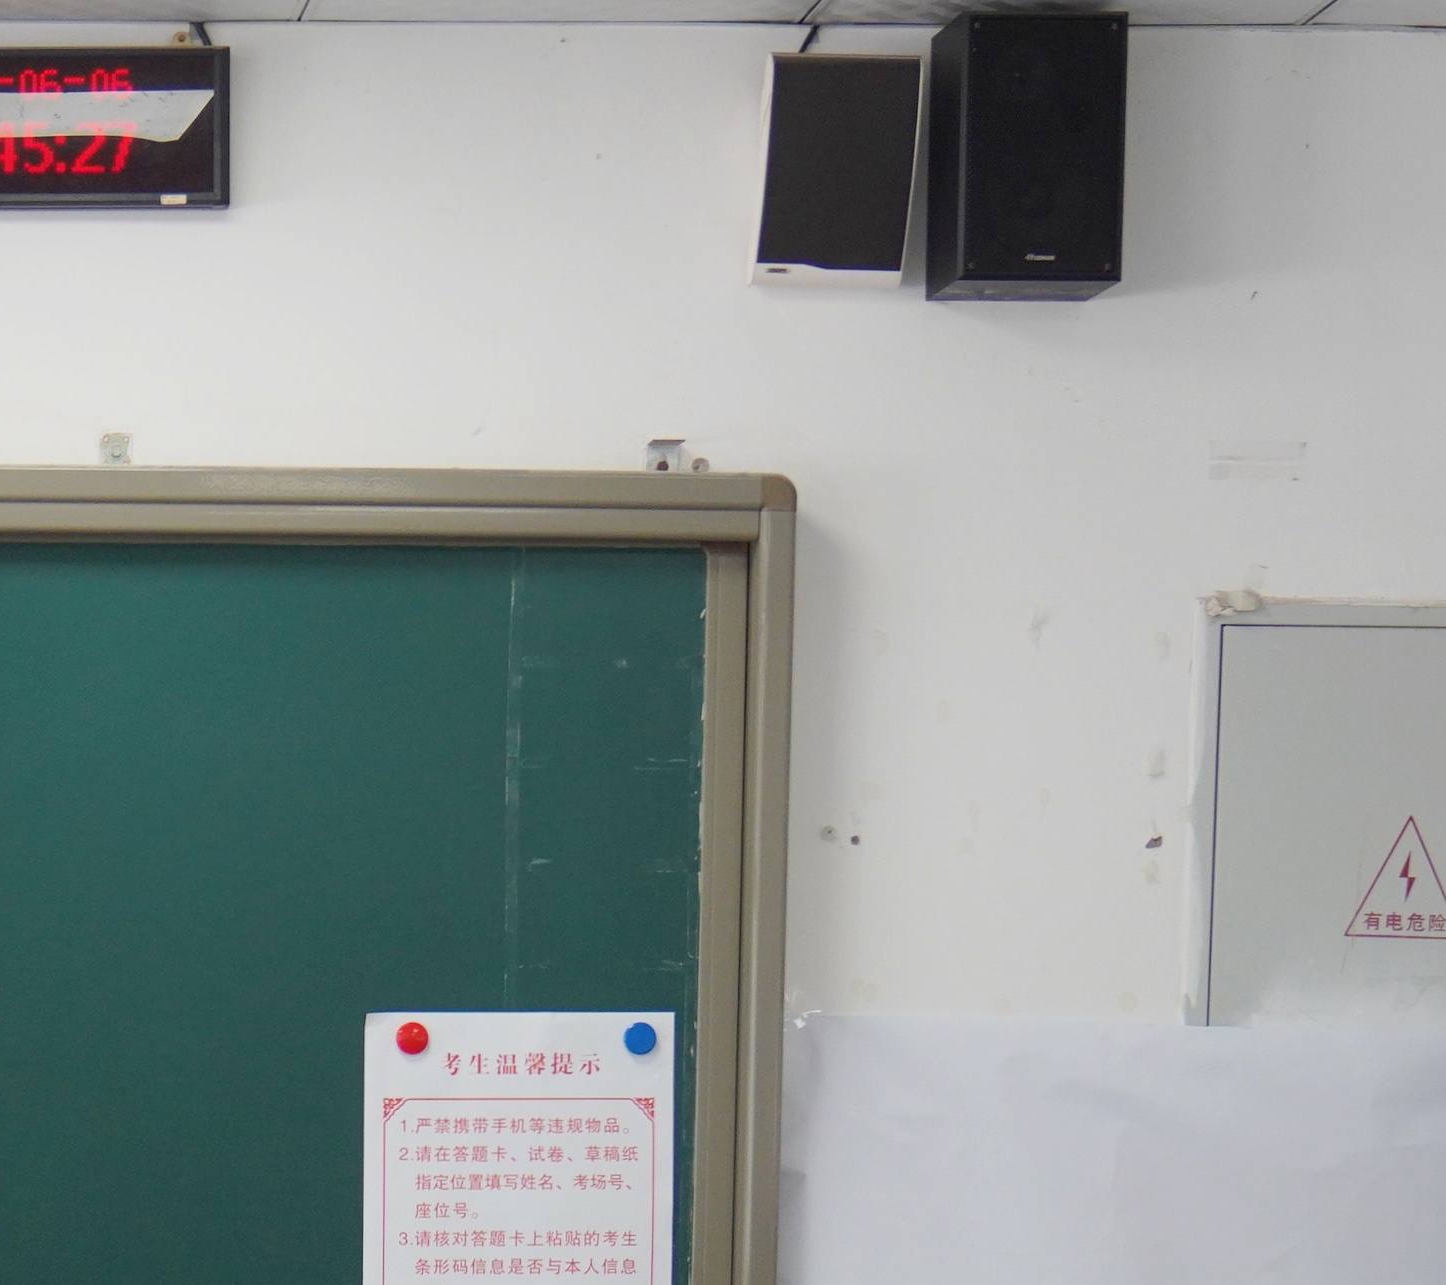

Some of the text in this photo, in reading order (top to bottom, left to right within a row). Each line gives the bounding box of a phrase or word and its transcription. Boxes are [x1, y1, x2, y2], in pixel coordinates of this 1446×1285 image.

[1364, 912, 1446, 932] 有电危险
[443, 1052, 602, 1077] 考生温馨提示
[414, 1202, 480, 1219] 座位号。
[414, 1258, 637, 1275] 条形码信息是否与本人信息
